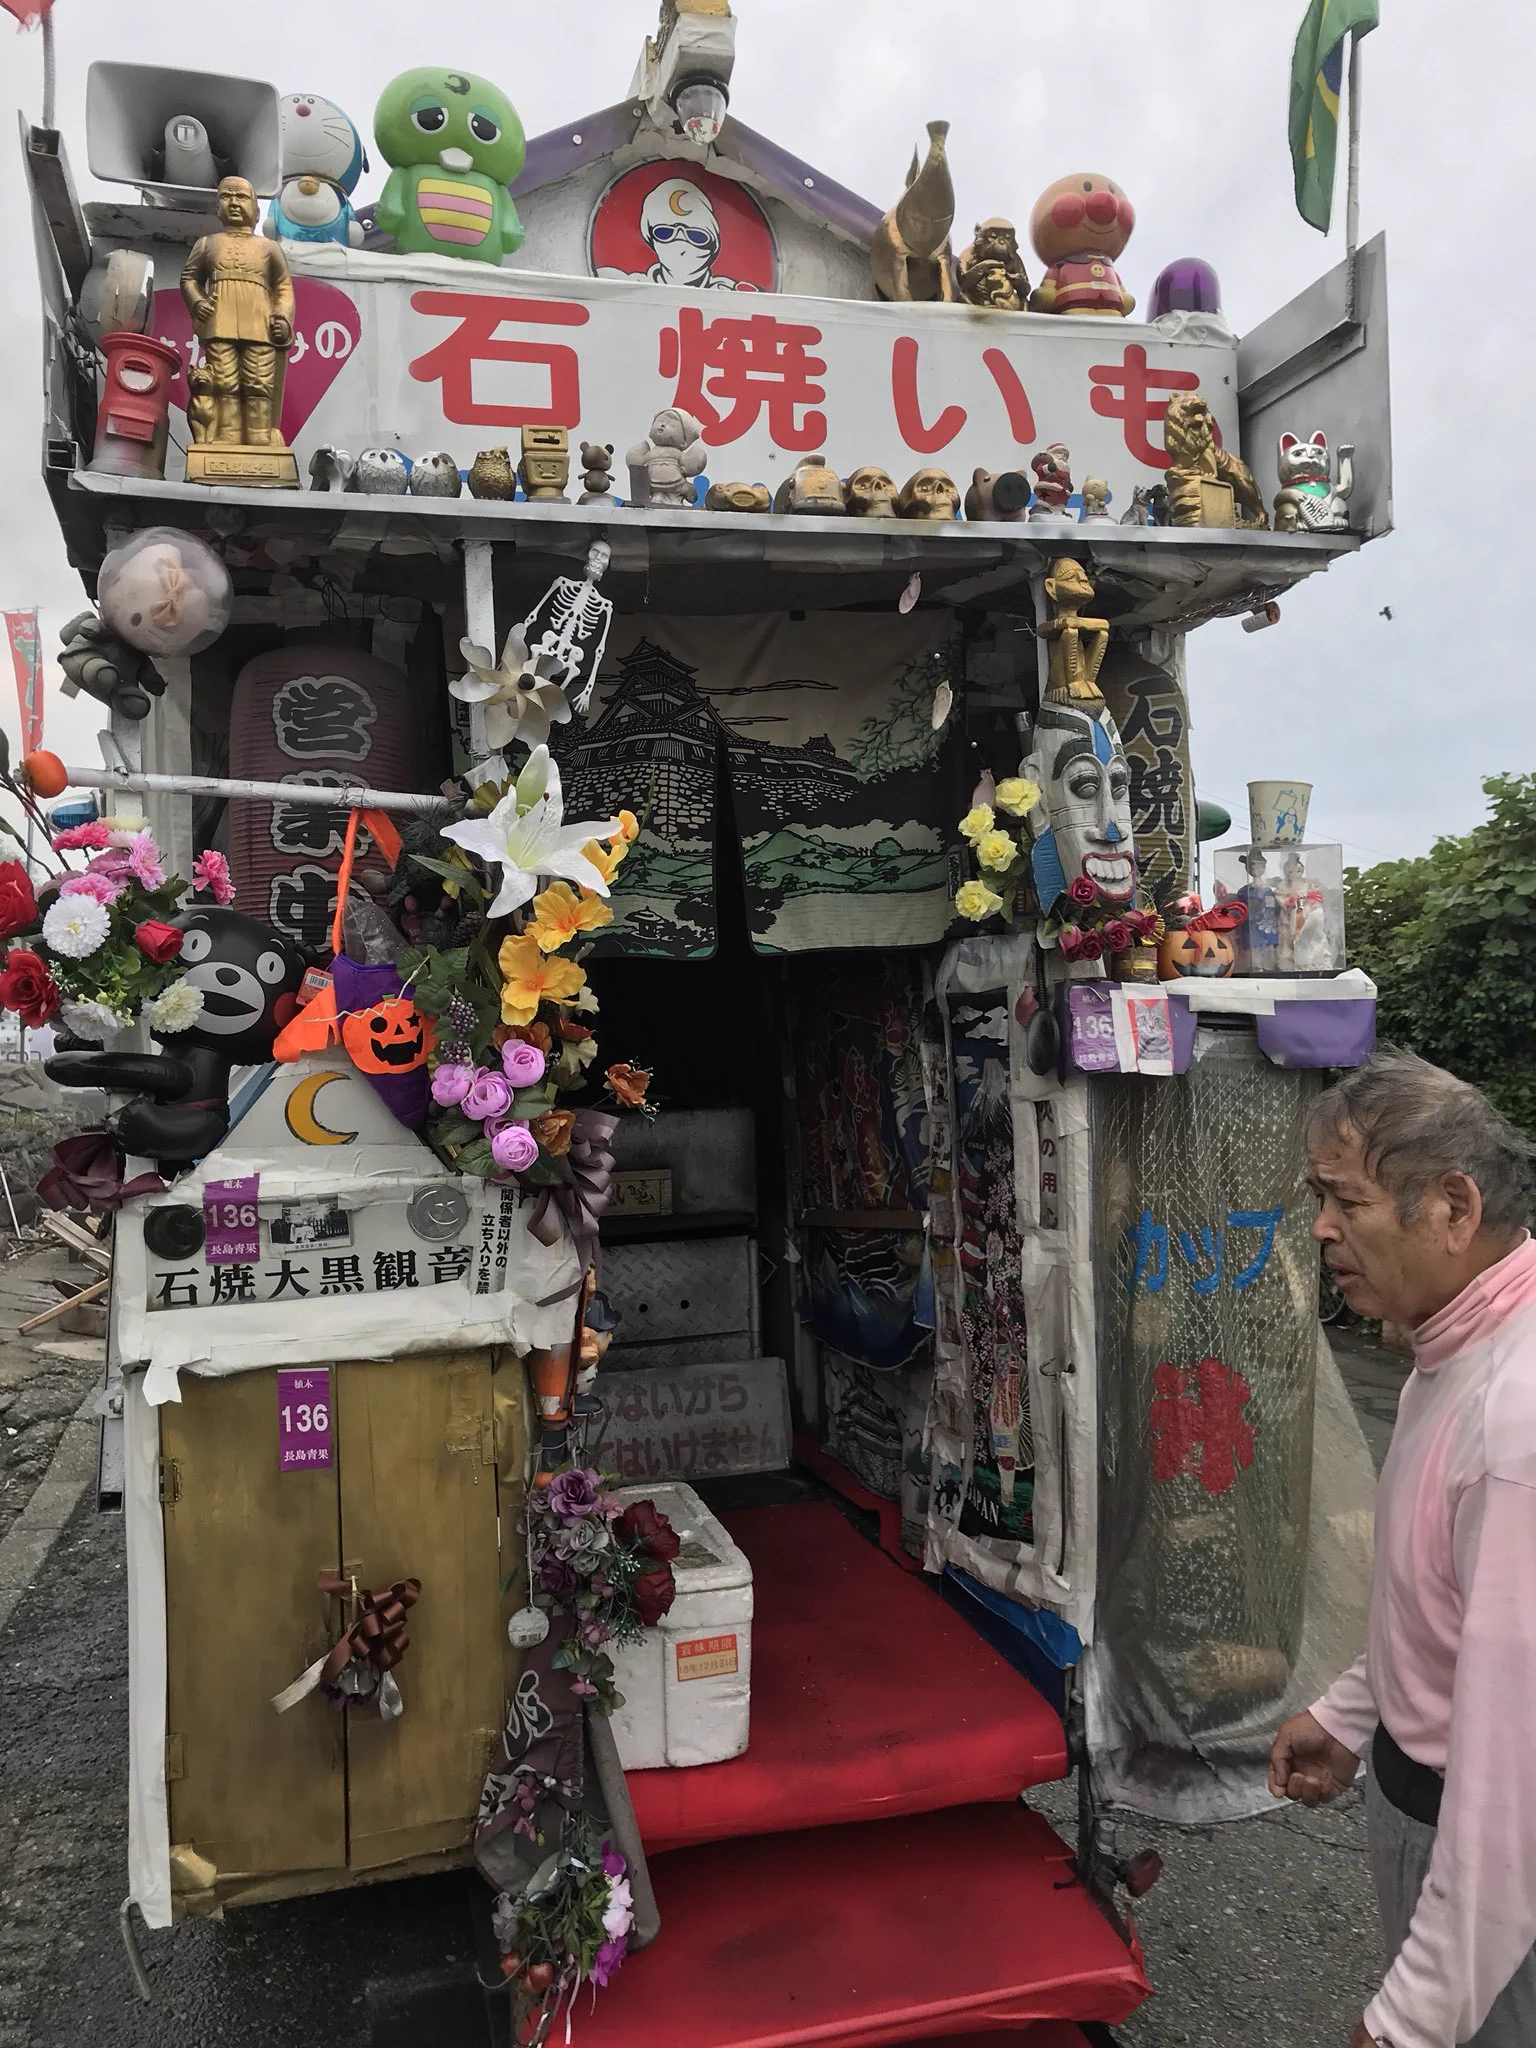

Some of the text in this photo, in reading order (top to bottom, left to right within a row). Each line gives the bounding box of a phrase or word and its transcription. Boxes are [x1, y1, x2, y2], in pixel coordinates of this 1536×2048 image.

[409, 290, 1222, 470] 石焼いも
[270, 675, 378, 954] 営業中
[1073, 1015, 1114, 1040] 136
[223, 1179, 243, 1190] 植木
[208, 1203, 256, 1229] 136
[495, 1188, 514, 1268] 関係者以外の
[210, 1244, 257, 1256] 長島青果
[476, 1213, 495, 1295] 立ち入りを禁
[155, 1246, 472, 1306] 石焼大黒観音
[294, 1378, 314, 1389] 植木
[281, 1403, 329, 1432] 136
[283, 1448, 329, 1462] 長島青果
